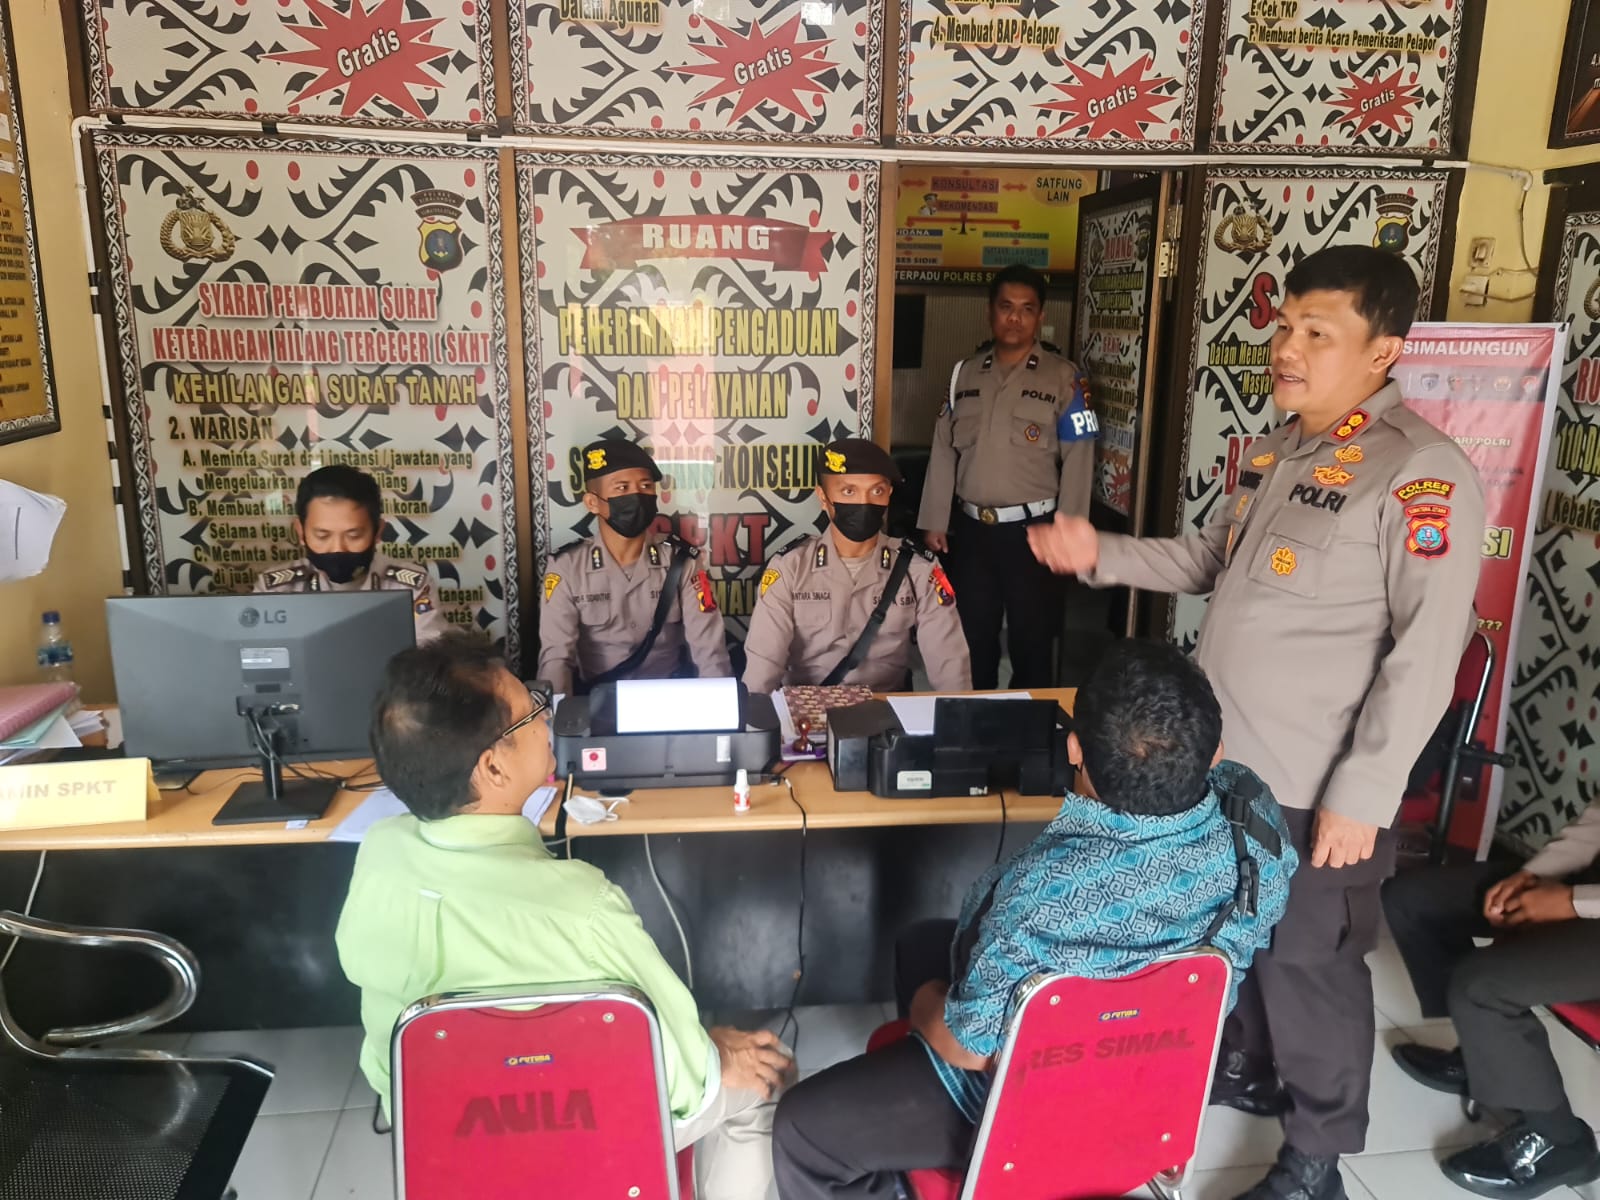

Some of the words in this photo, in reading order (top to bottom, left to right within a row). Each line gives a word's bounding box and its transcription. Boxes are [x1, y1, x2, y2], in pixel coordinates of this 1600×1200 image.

[1280, 0, 1298, 18] TKP
[946, 17, 994, 43] Membuat
[996, 18, 1018, 44] BAP
[1020, 19, 1061, 50] Pelapor
[1258, 25, 1297, 44] Membuat
[1298, 27, 1324, 45] berita
[1325, 28, 1350, 47] Acara
[1351, 30, 1404, 49] Pemeriksaan
[1406, 33, 1437, 54] Pelapor
[336, 27, 401, 77] Gratis
[733, 46, 793, 85] Gratis
[1086, 84, 1138, 118] Gratis
[1360, 88, 1396, 113] Gratis
[933, 178, 998, 193] KONSULTASI
[1036, 177, 1082, 190] SATFUNG
[1047, 191, 1069, 202] LAIN
[642, 223, 770, 250] RUANG
[896, 229, 930, 237] IDANA
[943, 271, 980, 282] POLRES
[199, 282, 268, 317] SYARAT
[272, 284, 378, 320] PEMBUATAN
[382, 286, 437, 321] SURAT
[709, 307, 839, 356] PENGADUAN
[152, 327, 271, 362] KETERANGAN
[274, 329, 340, 363] HILANG
[343, 330, 431, 365] TERCECER
[1208, 341, 1238, 367] Dalam
[1402, 340, 1529, 356] SIMALUNGUN
[173, 373, 321, 405] KEHILANGAN
[327, 375, 398, 406] SURAT
[404, 375, 477, 406] TANAH
[616, 371, 662, 420] DAN
[667, 371, 788, 420] PELAYANAN
[1021, 389, 1057, 404] POLRI
[168, 415, 186, 440] 2.
[190, 416, 274, 441] WARISAN
[1070, 408, 1100, 436] PR
[1450, 435, 1473, 447] ARI
[1475, 436, 1512, 447] POLRI
[183, 449, 197, 467] A.
[201, 449, 257, 467] Meminta
[260, 449, 296, 468] Surat
[329, 449, 379, 467] instansi
[391, 450, 440, 470] jawatan
[445, 453, 473, 470] yang
[722, 444, 825, 490] KONSELIN
[203, 472, 295, 494] Mengeluarkan
[1398, 480, 1450, 498] POLRES
[188, 500, 203, 516] B.
[206, 499, 266, 516] Membuat
[270, 498, 298, 515] Ikla
[392, 499, 429, 515] koran
[1289, 483, 1348, 514] POLRI
[1552, 490, 1600, 532] Kebaka
[209, 522, 257, 539] Selama
[261, 522, 287, 543] tiga
[1481, 527, 1512, 558] SI
[211, 546, 266, 562] Meminta
[417, 544, 460, 562] pernah
[213, 569, 225, 585] di
[437, 585, 483, 606] tangani
[263, 609, 288, 624] LG
[443, 608, 472, 624] atas
[57, 779, 117, 798] SPKT
[455, 1088, 596, 1138] AULA
